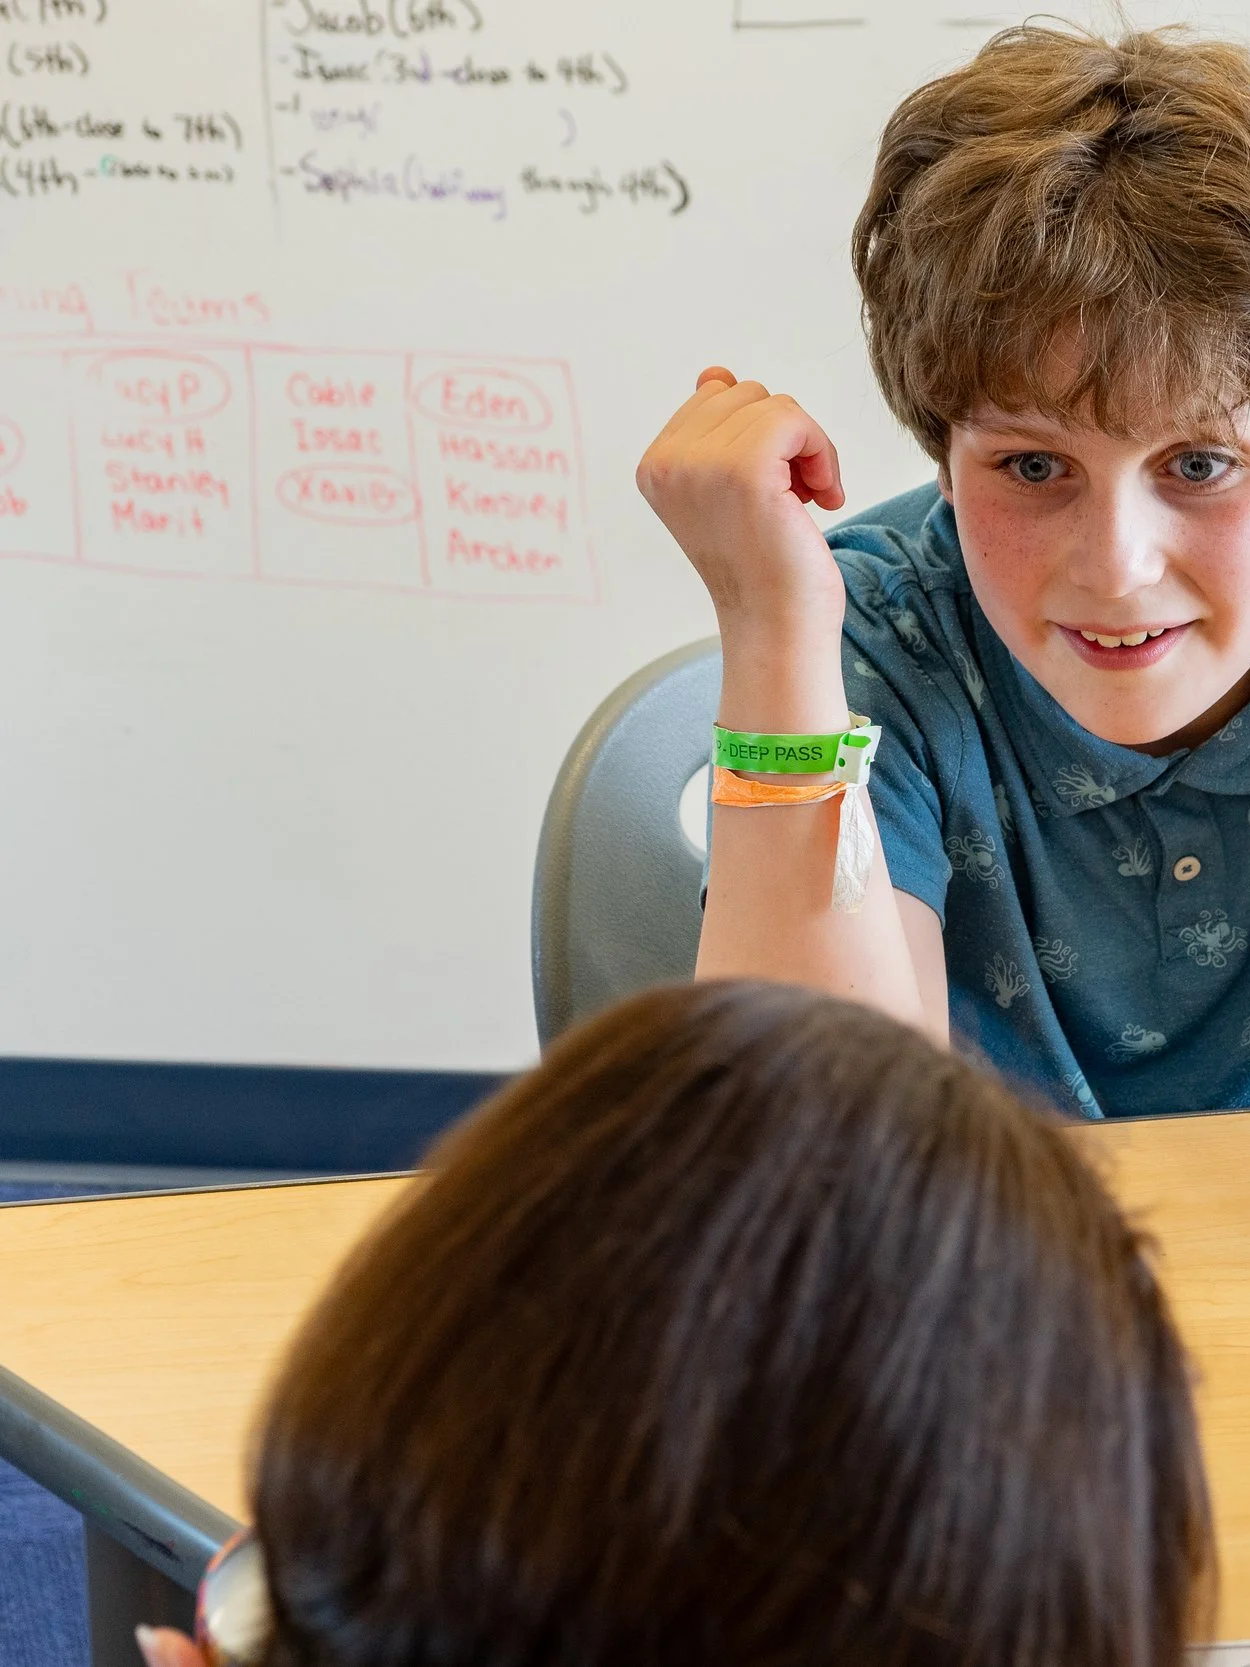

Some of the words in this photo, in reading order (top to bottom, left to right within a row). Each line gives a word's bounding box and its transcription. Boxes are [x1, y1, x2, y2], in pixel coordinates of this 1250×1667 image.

[440, 376, 532, 425] Eden
[728, 743, 770, 762] DEEP
[775, 746, 823, 762] PASS
